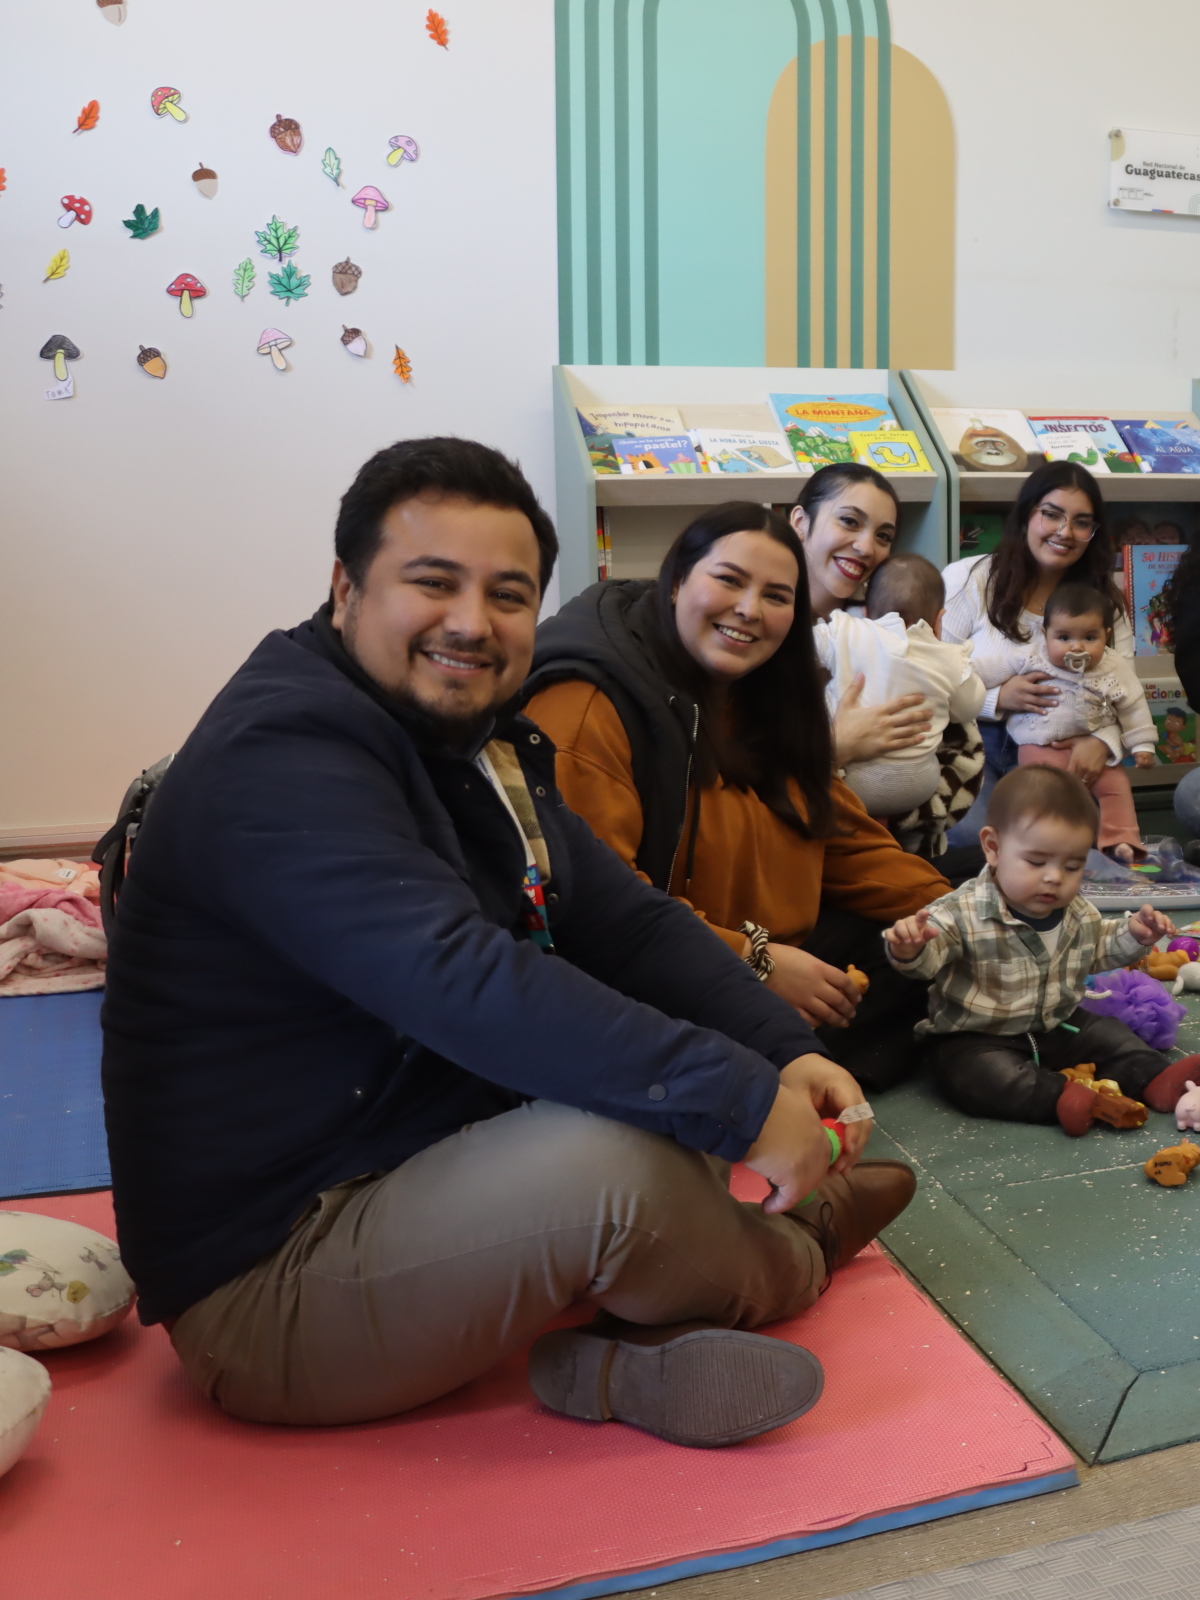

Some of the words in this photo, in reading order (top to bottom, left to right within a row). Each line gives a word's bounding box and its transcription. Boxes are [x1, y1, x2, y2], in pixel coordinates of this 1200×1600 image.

[1154, 162, 1178, 170] Nacional
[589, 411, 631, 420] Imposible
[614, 421, 671, 432] hipopótamo
[1043, 424, 1107, 433] INSECTOS
[643, 440, 688, 451] pastel?
[1142, 552, 1156, 562] 50
[1158, 551, 1184, 562] HIST
